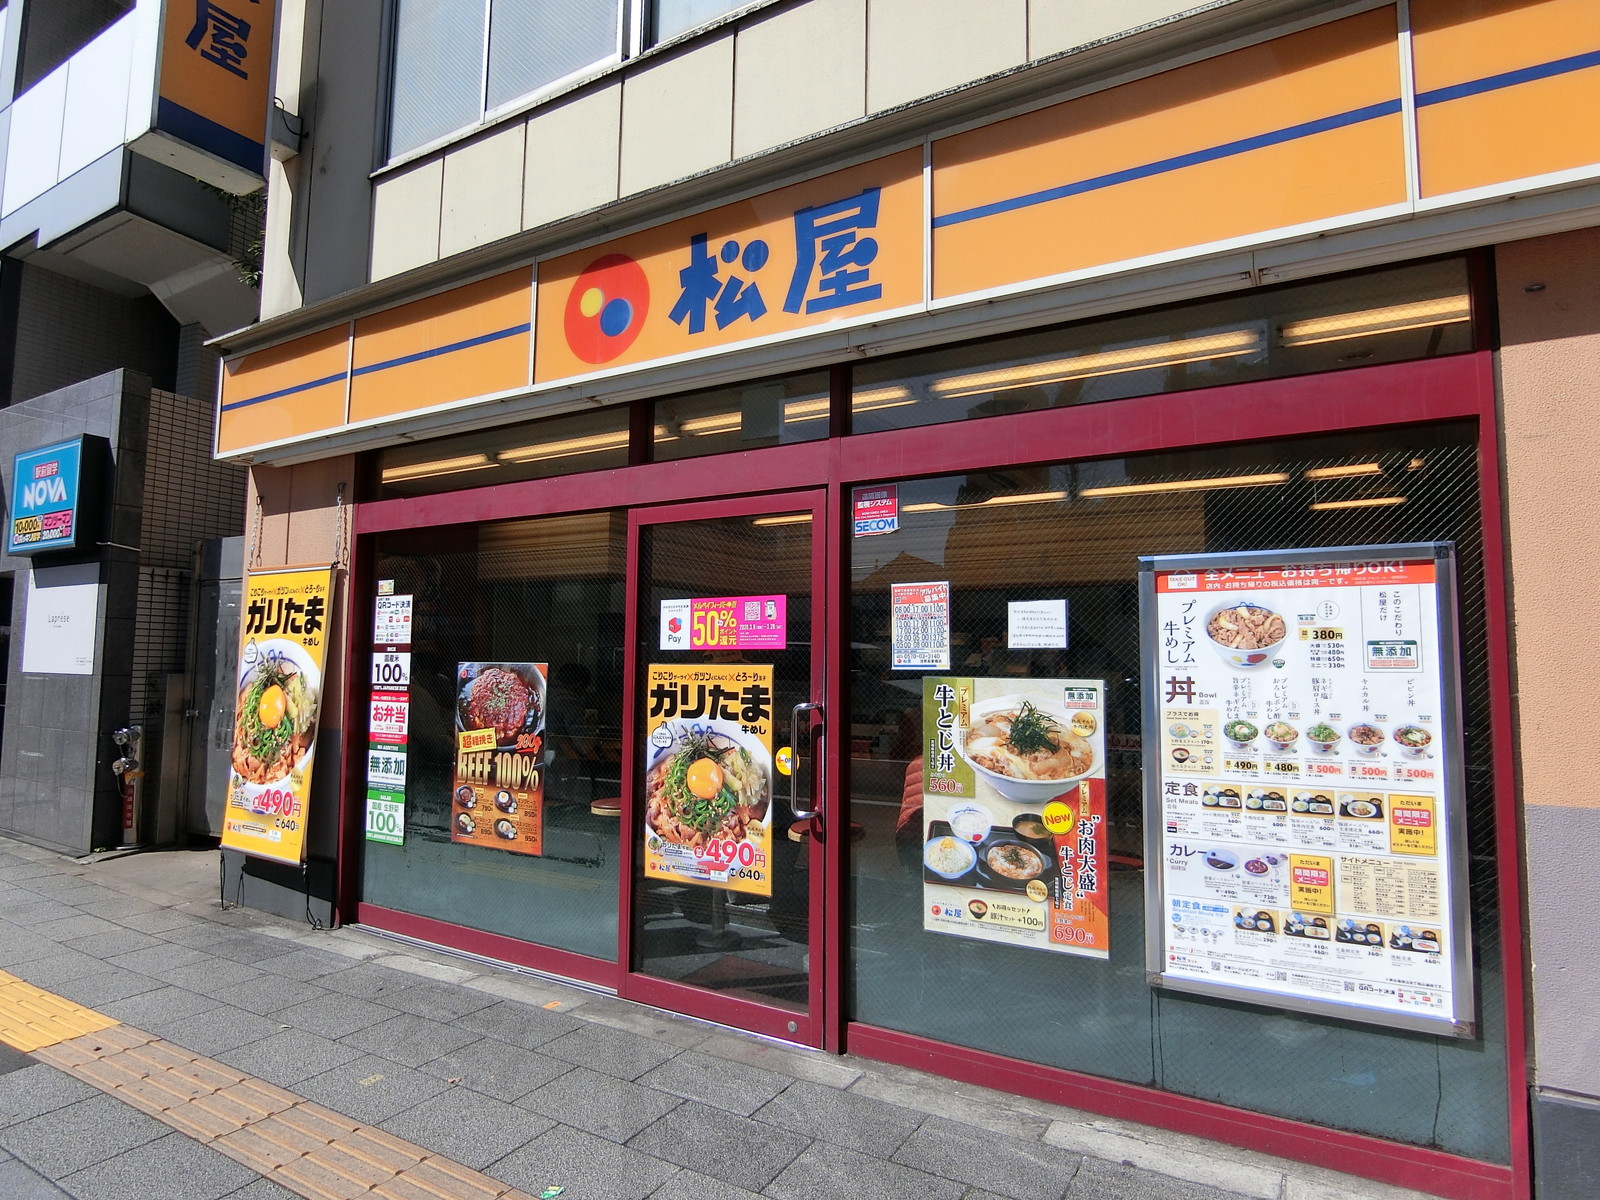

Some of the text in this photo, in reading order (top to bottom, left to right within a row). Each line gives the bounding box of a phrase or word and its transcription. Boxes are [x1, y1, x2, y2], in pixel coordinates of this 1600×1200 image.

[185, 0, 260, 80] 屋
[669, 187, 882, 334] 松屋
[23, 477, 67, 511] NOVA
[857, 499, 892, 509] 監視システム
[856, 519, 894, 532] SECOM
[920, 584, 948, 596] アルバイト
[1379, 591, 1387, 621] 松屋だけ
[1393, 590, 1402, 637] このこだわり
[246, 596, 324, 635] ガリたま
[692, 610, 737, 646] 50%
[1182, 599, 1197, 663] プレミアム
[1313, 630, 1342, 640] 380円
[303, 637, 319, 646] 牛めし
[668, 634, 681, 644] Pay
[720, 635, 737, 646] 還元
[1163, 621, 1180, 663] 牛めし
[1372, 646, 1412, 657] 無添加
[375, 664, 408, 682] 100%
[1067, 692, 1093, 700] 無添加
[1166, 676, 1196, 704] 丼
[650, 682, 771, 723] ガリたま
[960, 688, 968, 727] プレミアム
[373, 705, 406, 724] お弁当
[741, 725, 766, 735] 牛めし
[934, 684, 955, 772] 牛とじ丼
[516, 733, 542, 754] 200g
[370, 755, 404, 776] 無添加
[457, 752, 539, 791] BEEF 100%
[1234, 761, 1258, 770] 490円
[1274, 763, 1299, 772] 480円
[1317, 765, 1342, 774] 500円
[1362, 767, 1387, 776] 500円
[1407, 769, 1434, 778] 500円
[929, 778, 964, 793] 560円
[1165, 781, 1198, 796] 定食
[1080, 783, 1088, 814] プレミアム
[369, 811, 402, 833] 100%
[1045, 813, 1070, 826] New
[1398, 828, 1424, 836] 実施中!
[706, 839, 766, 868] 490円
[1170, 844, 1207, 857] カレー
[1341, 857, 1390, 866] サイドメニュー
[739, 870, 766, 881] 640円
[1060, 847, 1074, 910] 牛とじ定食
[1298, 886, 1322, 895] 実施中!
[1172, 899, 1201, 910] 朝定食
[945, 907, 962, 918] 松屋
[1018, 915, 1043, 927] +100円
[1054, 925, 1094, 944] 690円
